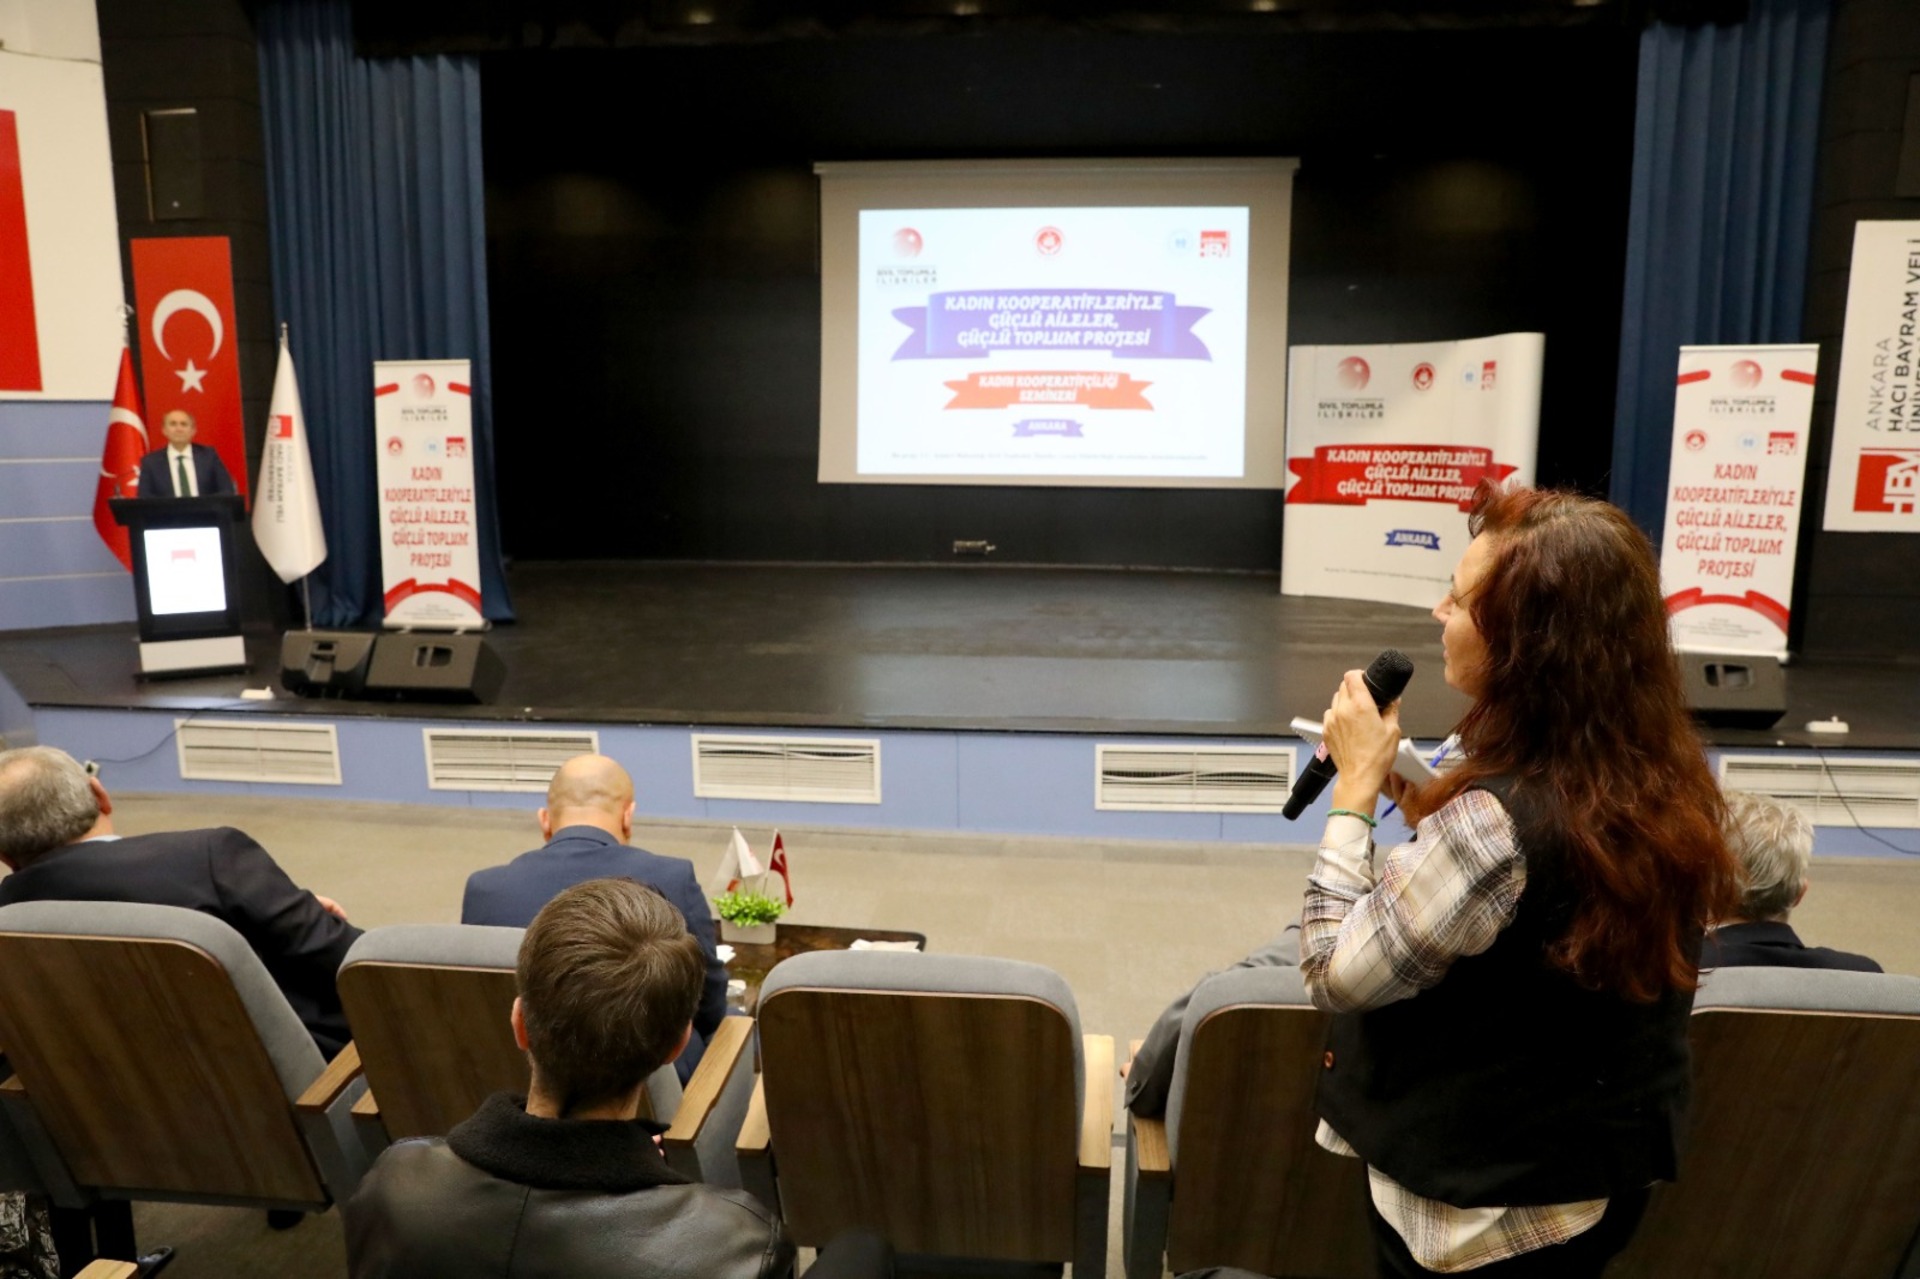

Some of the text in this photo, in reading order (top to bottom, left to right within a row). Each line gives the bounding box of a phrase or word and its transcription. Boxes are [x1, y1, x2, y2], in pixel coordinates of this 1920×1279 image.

[945, 293, 1164, 311] KADIN KOOPERATİFLERİYLE
[989, 312, 1043, 330] GÜÇLÜ
[957, 329, 1152, 349] GÜÇLÜ TOPLUM PROJESİ
[1894, 291, 1919, 377] BAYRAM
[1866, 338, 1892, 431] ANKARA
[1888, 385, 1908, 432] HACI
[1327, 449, 1371, 463] KADIN
[411, 466, 442, 480] KADIN
[1364, 464, 1410, 481] GÜÇLÜ
[1714, 464, 1758, 480] KADIN
[1337, 479, 1384, 497] GÜÇLÜ
[1385, 482, 1437, 498] TOPLUM
[1673, 485, 1796, 506] KOOPERATİFLERİYLE
[389, 506, 422, 526] GÜÇLÜ
[1676, 507, 1722, 531] GÜÇLÜ
[392, 528, 469, 549] GÜÇLÜ TOPLUM
[1676, 531, 1783, 555] GÜÇLÜ TOPLUM
[1698, 559, 1757, 579] PROJESİ
